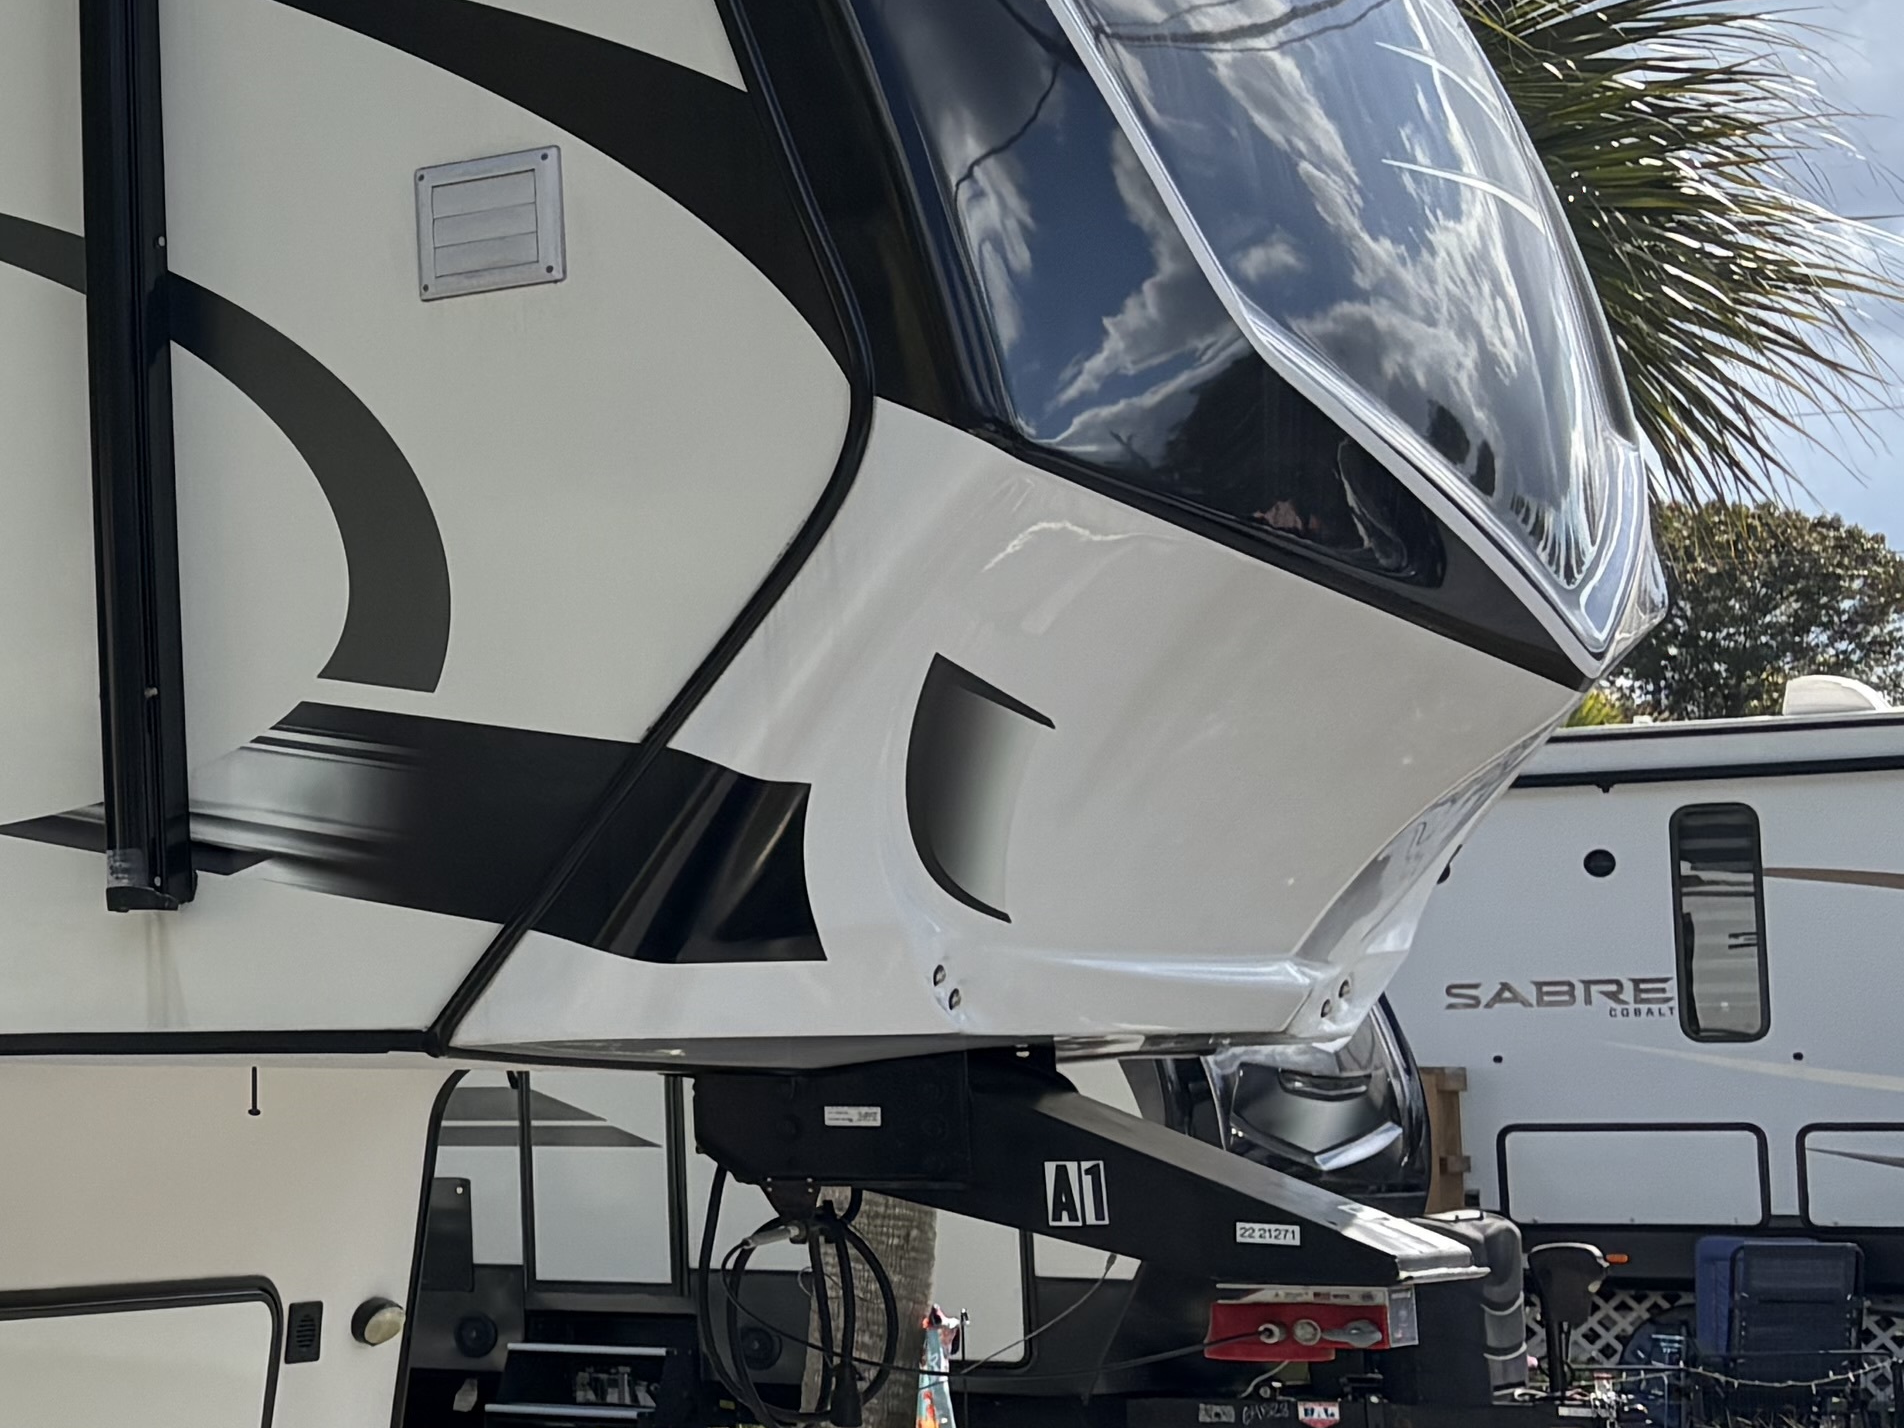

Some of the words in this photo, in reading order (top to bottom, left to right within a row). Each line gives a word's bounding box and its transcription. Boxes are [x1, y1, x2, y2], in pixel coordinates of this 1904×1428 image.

[1444, 976, 1675, 1011] SABRE
[1608, 1005, 1676, 1019] COBALT
[1051, 1162, 1106, 1223] A1
